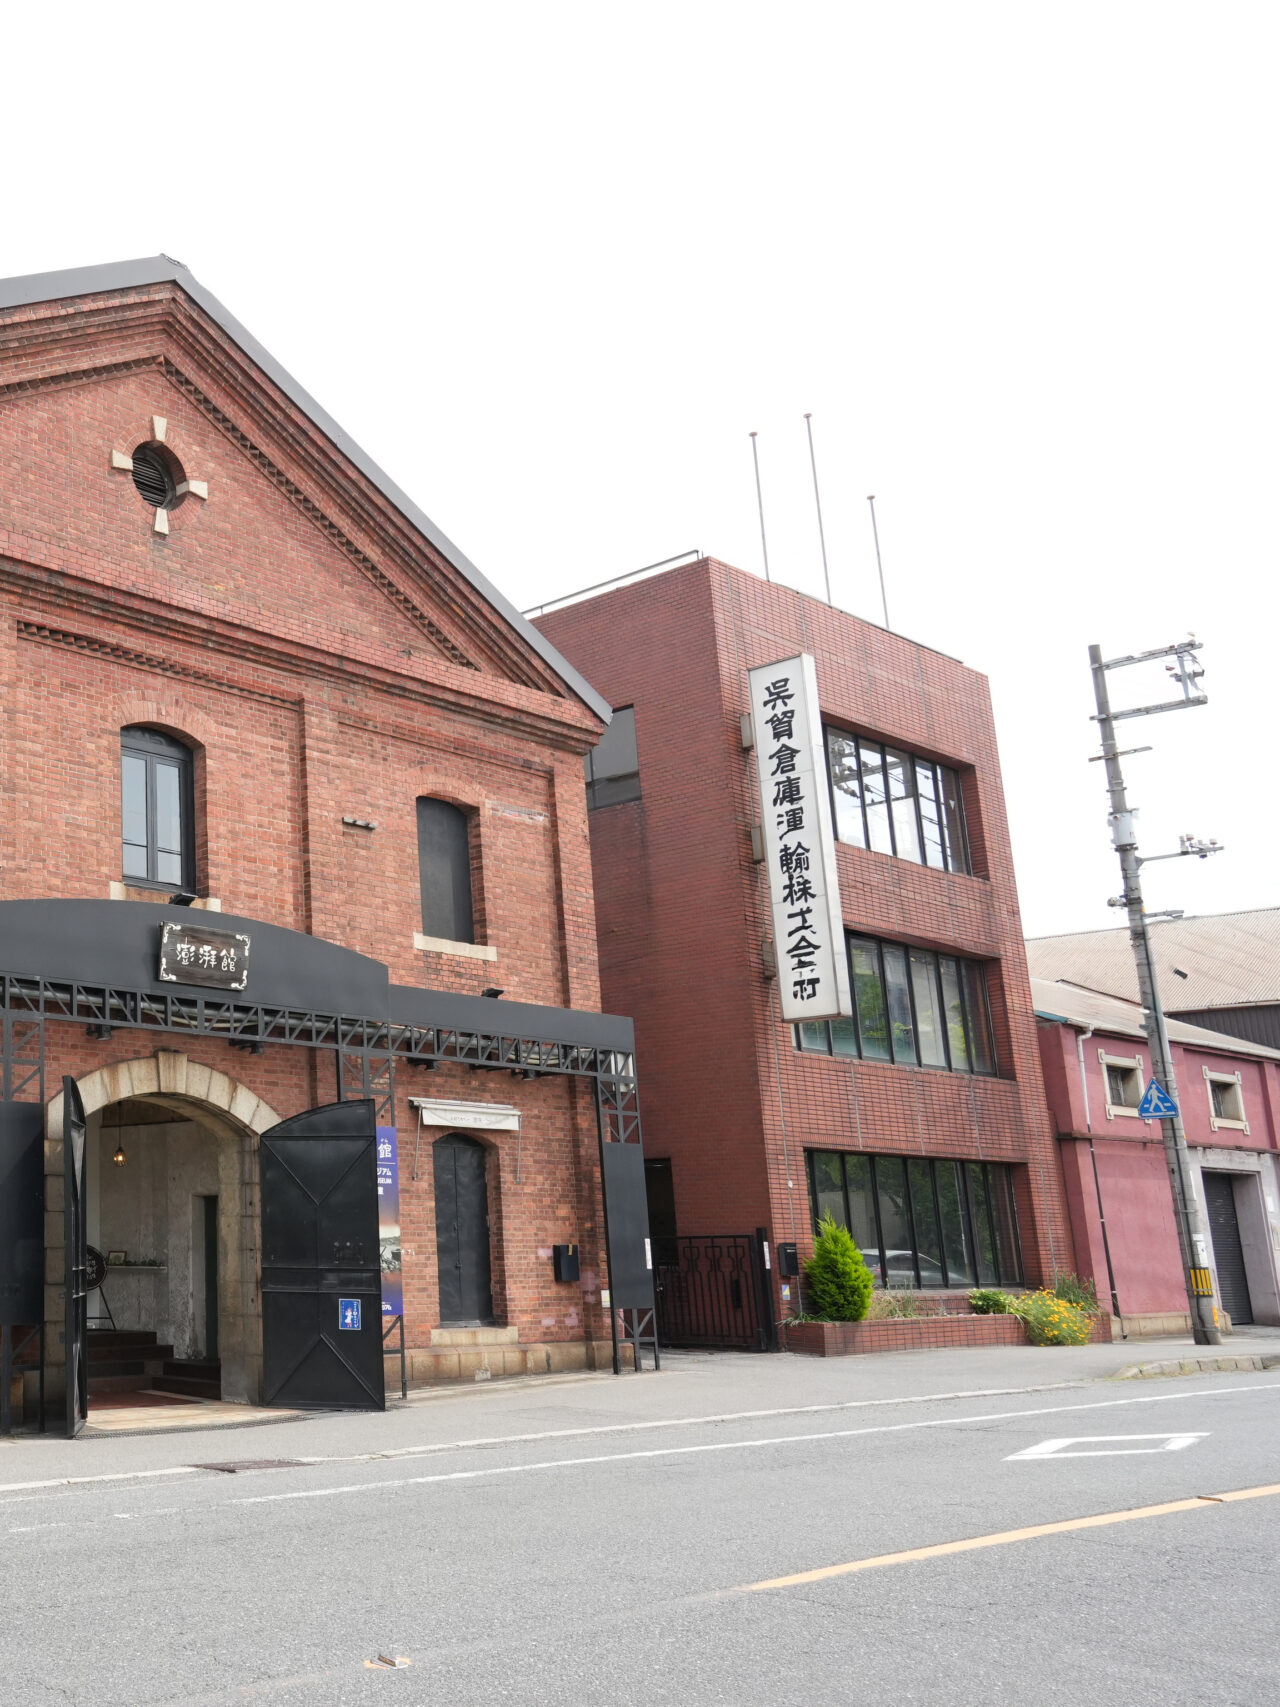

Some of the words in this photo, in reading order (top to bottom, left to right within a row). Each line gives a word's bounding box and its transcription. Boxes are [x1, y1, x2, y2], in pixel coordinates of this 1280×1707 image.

[177, 938, 236, 971] 澎湃館
[378, 1144, 392, 1158] 館
